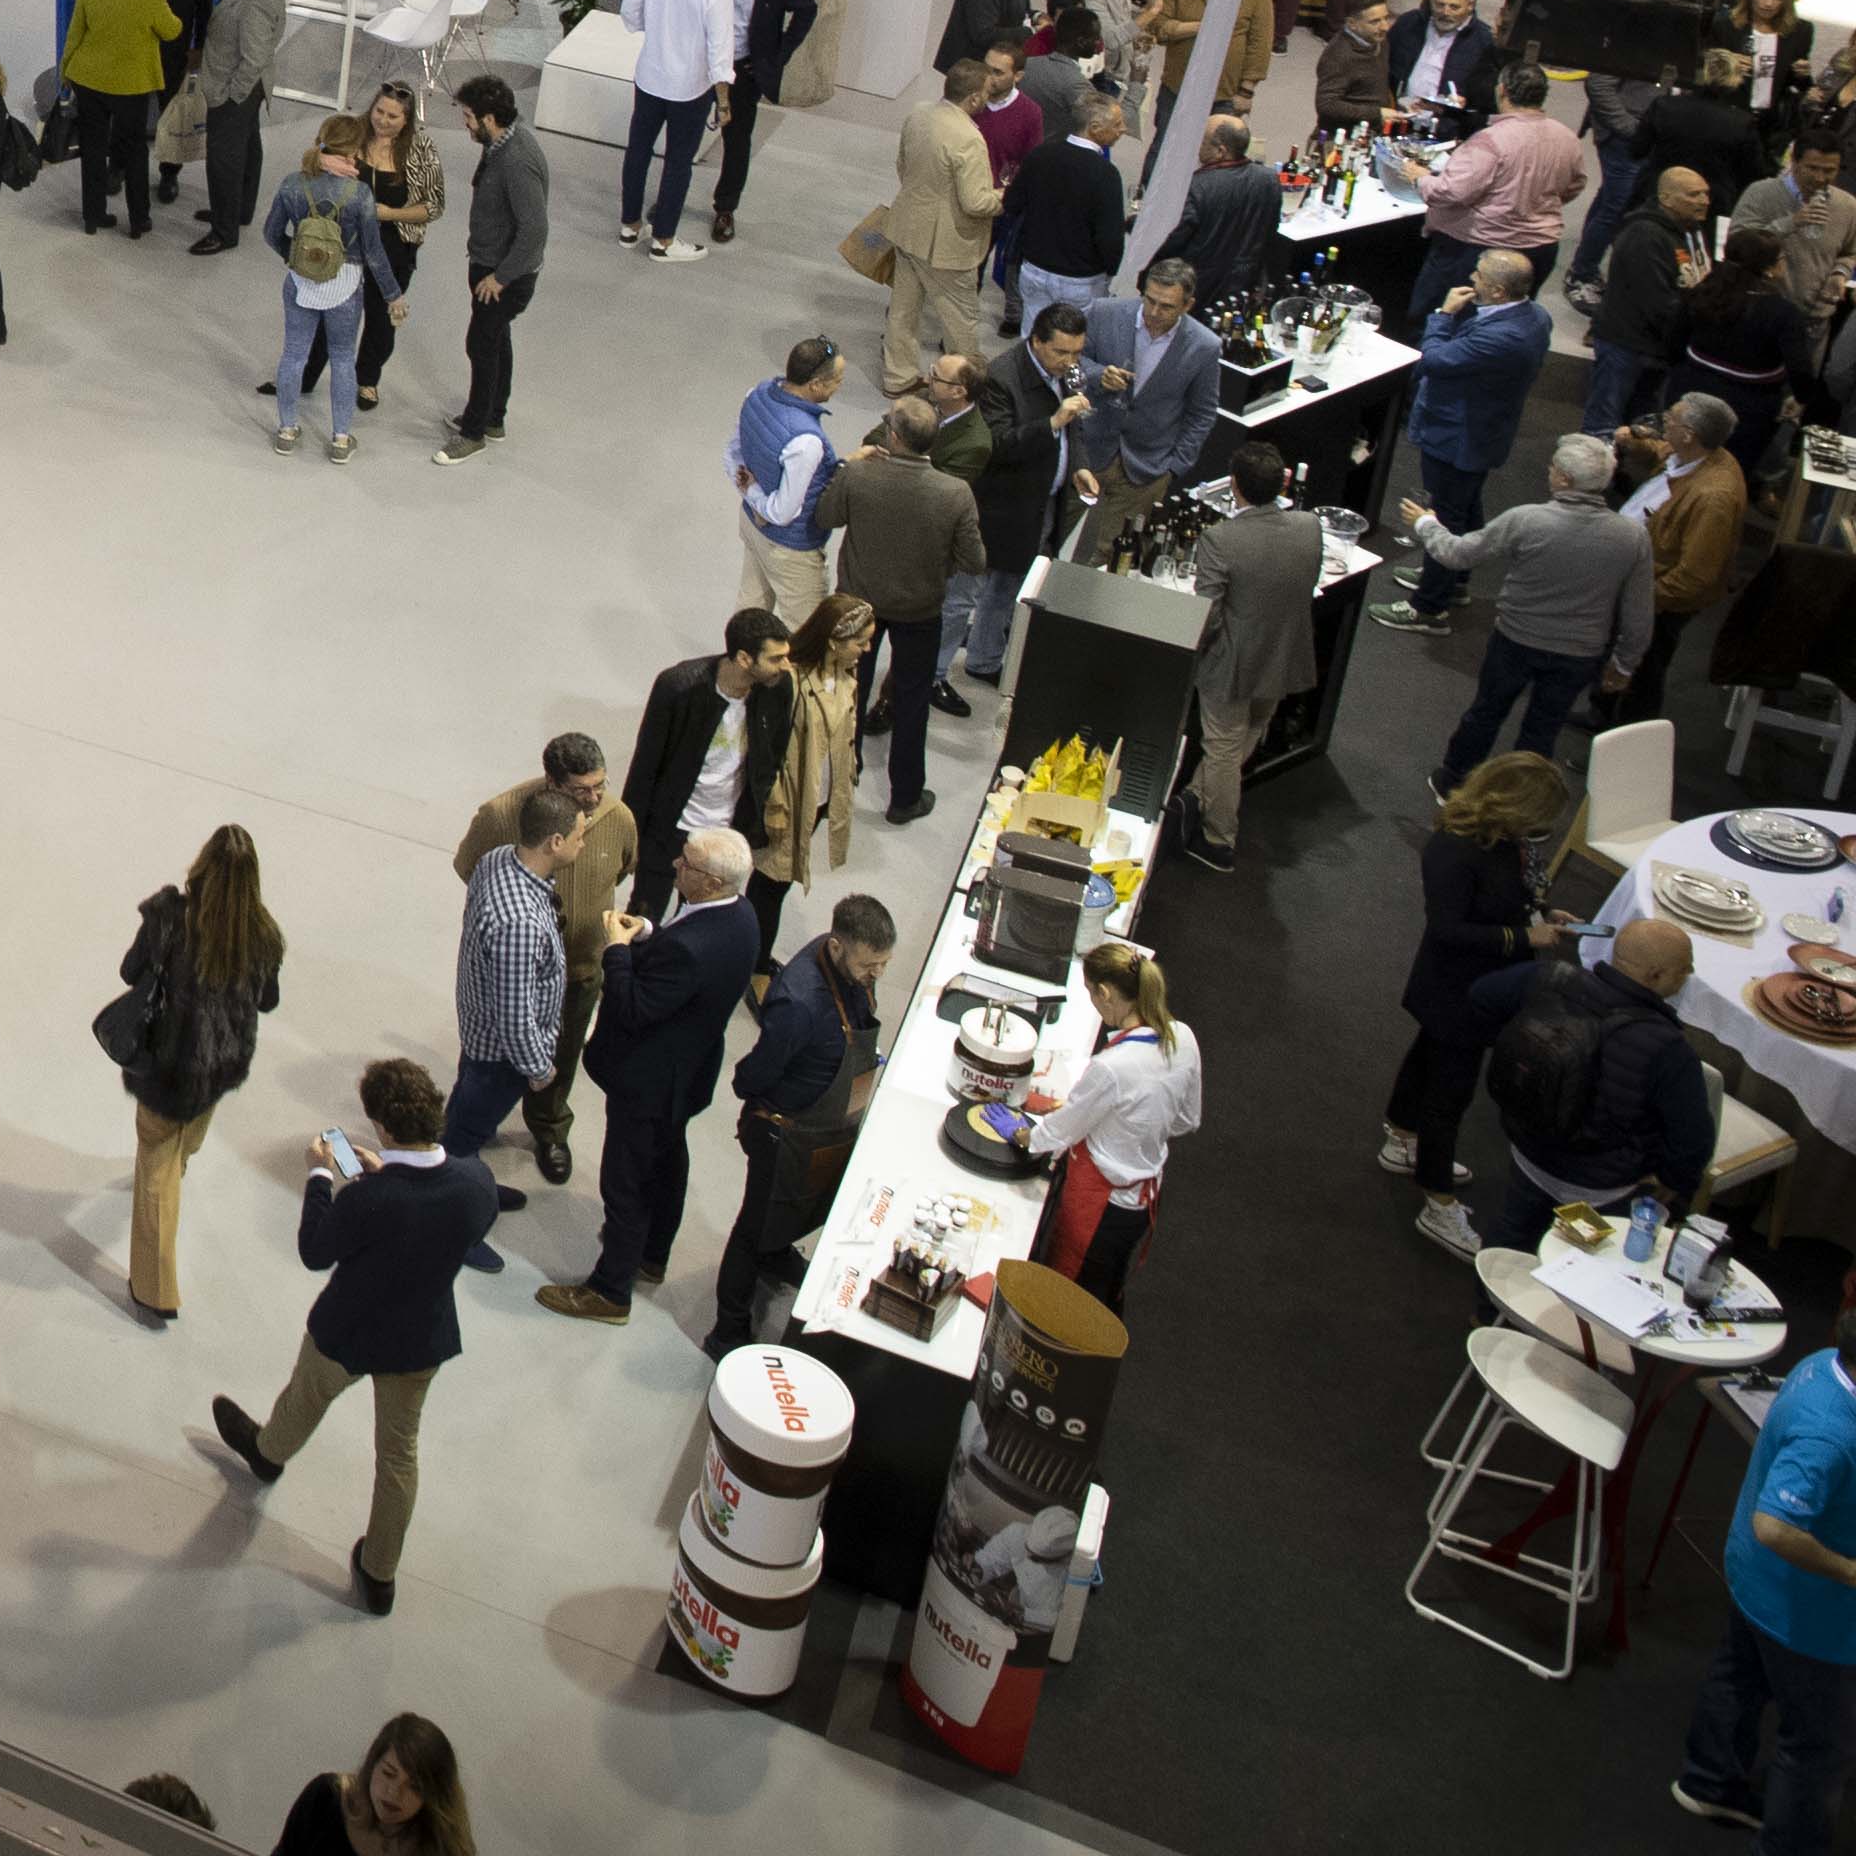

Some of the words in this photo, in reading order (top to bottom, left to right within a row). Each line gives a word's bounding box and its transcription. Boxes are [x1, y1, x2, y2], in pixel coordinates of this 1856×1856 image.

[961, 1066, 1015, 1090] nutella
[869, 1185, 895, 1228] nutella
[836, 1266, 861, 1308] nutella
[762, 1353, 810, 1432] nutella
[923, 1600, 993, 1672] nutella
